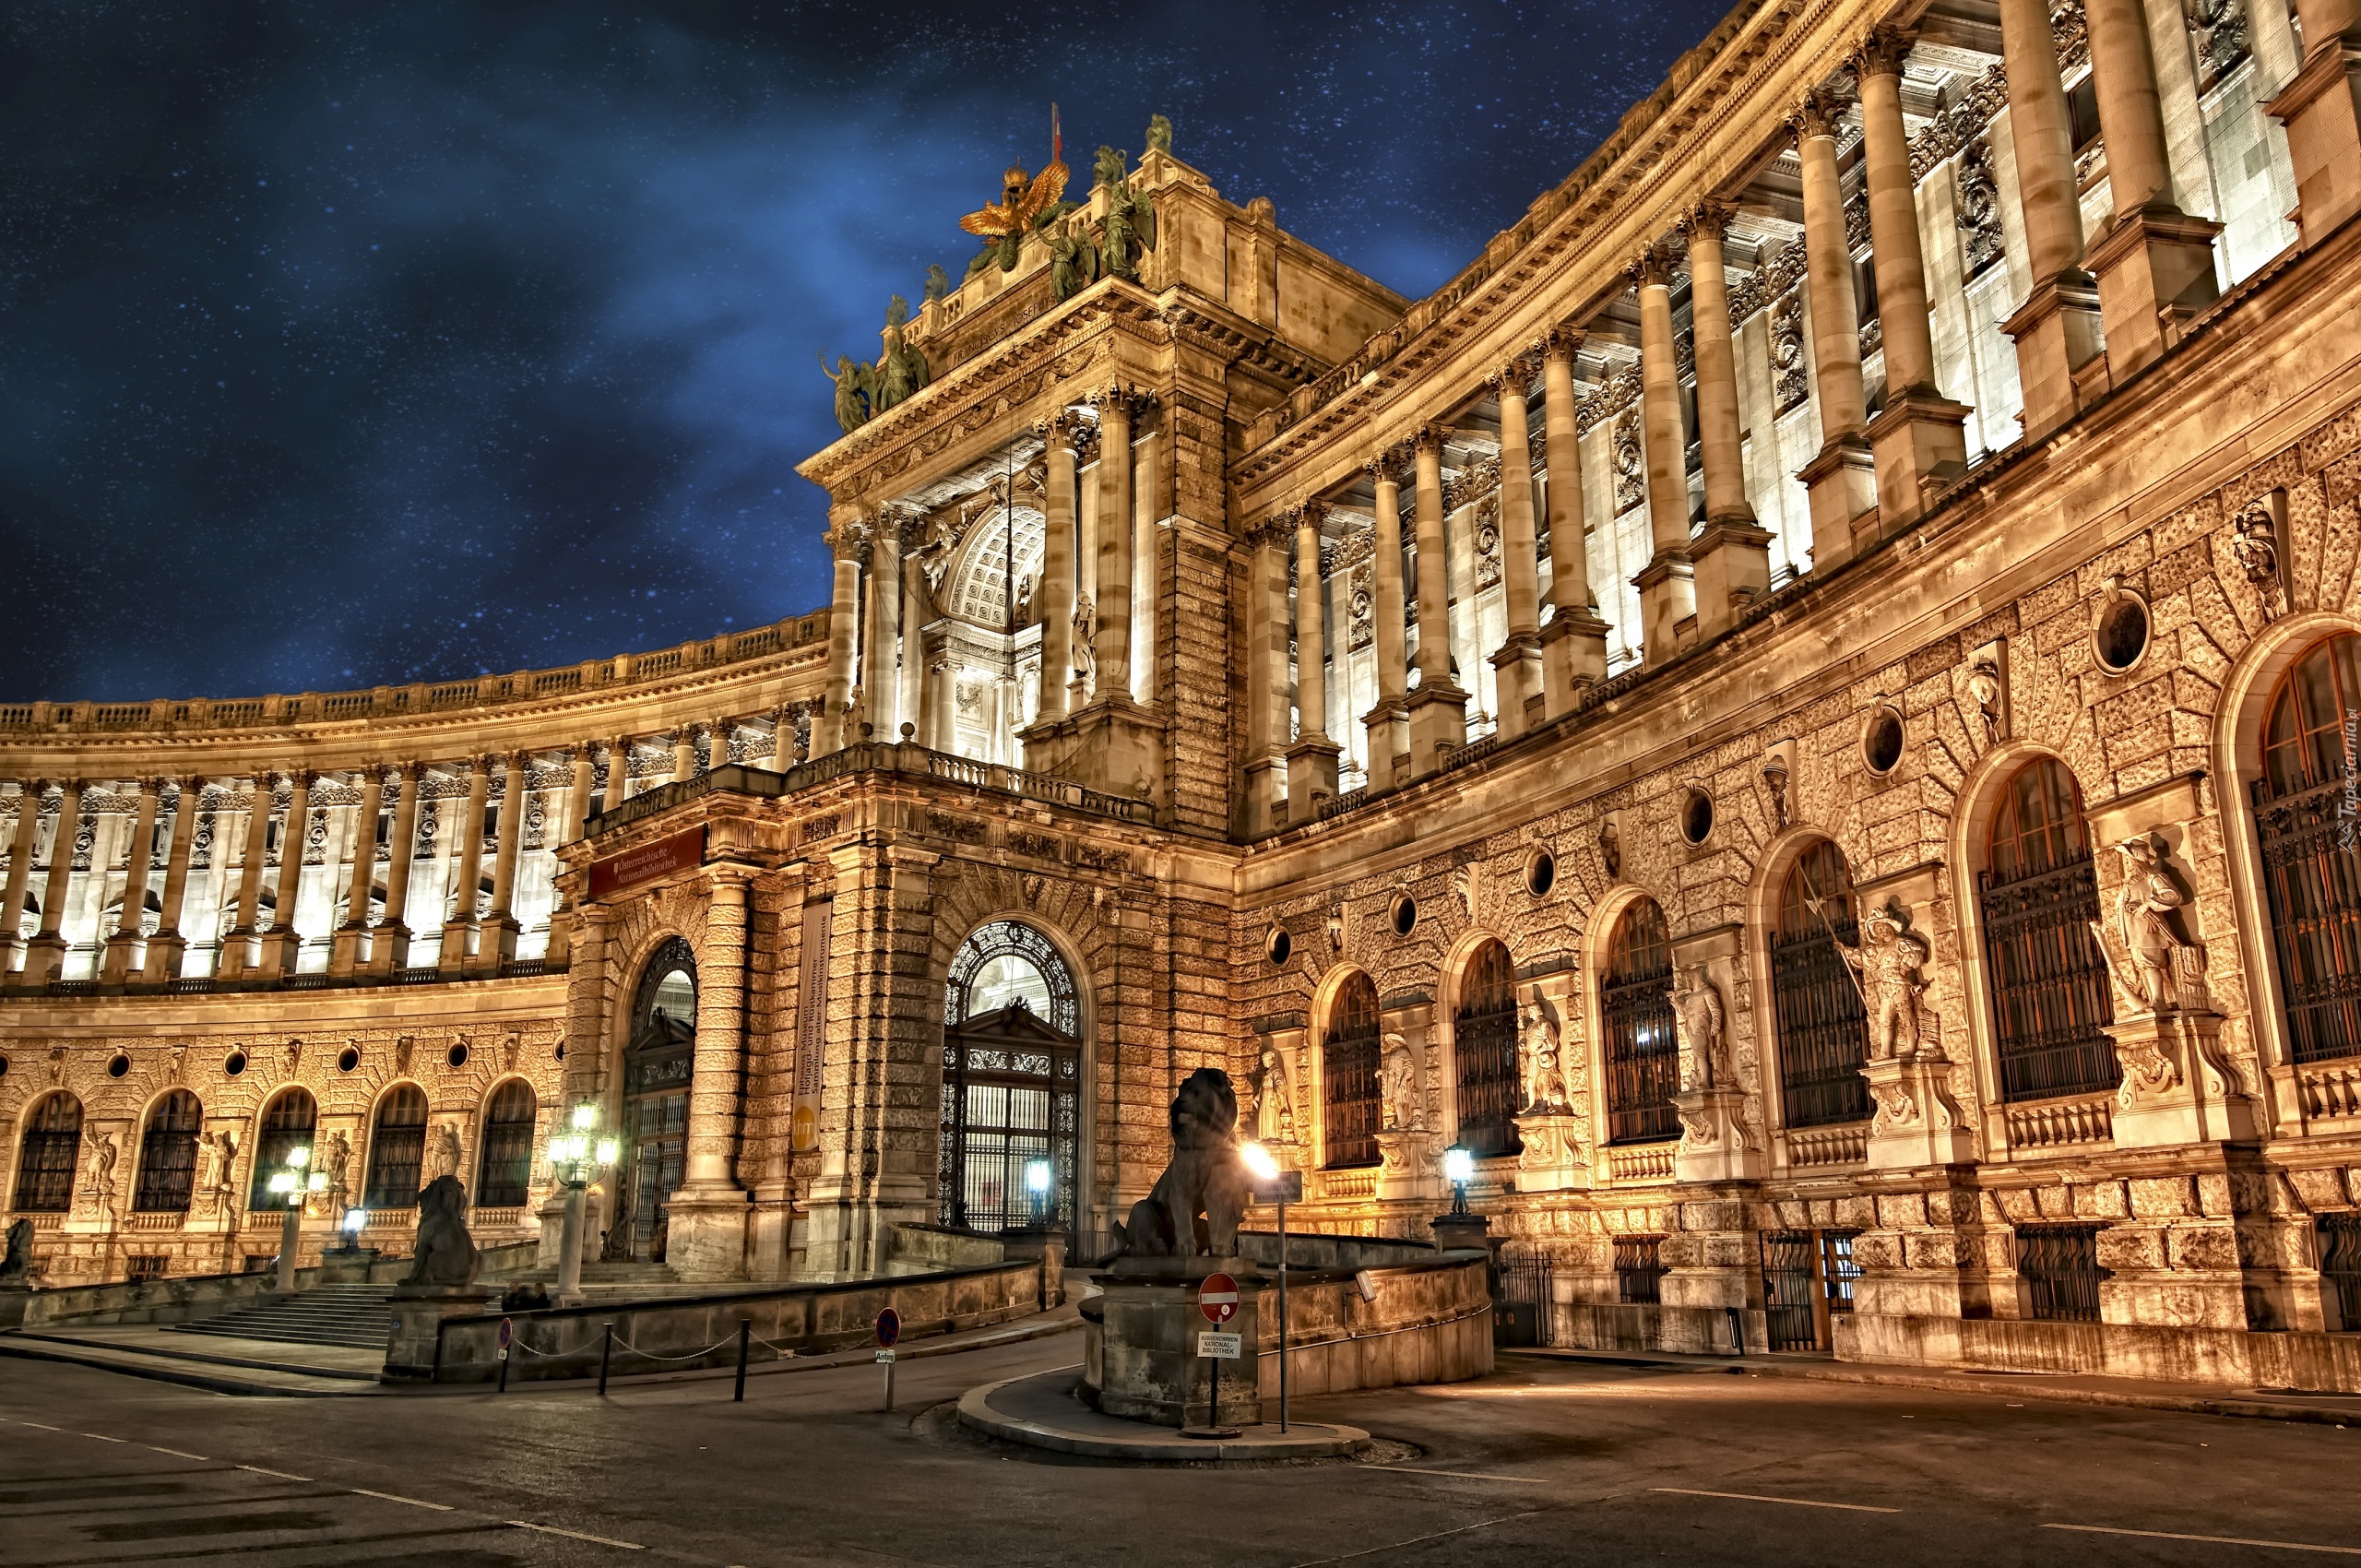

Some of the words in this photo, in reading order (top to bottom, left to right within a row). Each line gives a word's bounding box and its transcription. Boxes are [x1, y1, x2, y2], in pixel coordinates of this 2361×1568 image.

[618, 856, 677, 885] Nationalbibliothek
[619, 847, 668, 872] Österreichische
[816, 916, 826, 1007] Musikinstrumente
[804, 1051, 813, 1095] Hofjagd-
[809, 958, 818, 1022] Rüstkammer
[812, 1038, 821, 1095] Sammlung
[1201, 1335, 1239, 1343] AUSGENOMMEN
[876, 1352, 894, 1362] Anfang
